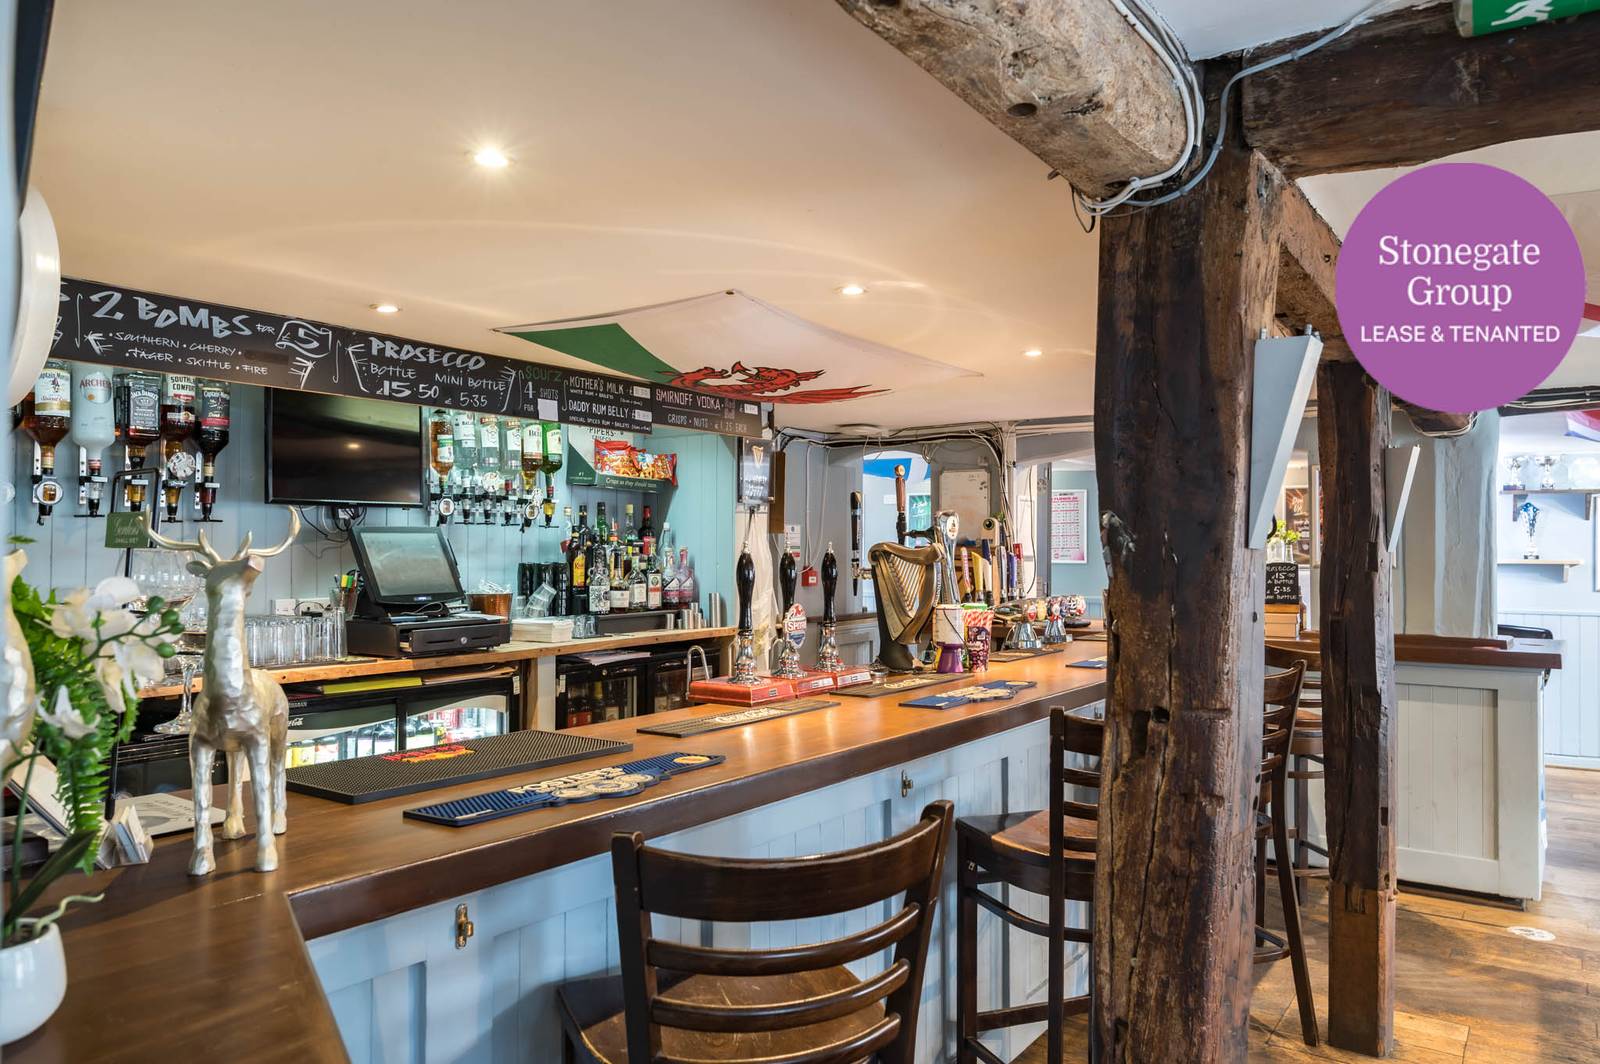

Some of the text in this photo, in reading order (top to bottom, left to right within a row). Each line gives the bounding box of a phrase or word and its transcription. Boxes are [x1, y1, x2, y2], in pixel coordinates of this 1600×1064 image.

[133, 296, 253, 339] BOMBS
[115, 332, 237, 356] SOUTHERN CHERRY
[368, 336, 486, 370] PROSECCO
[185, 357, 232, 370] SKITTLE
[242, 364, 268, 375] FIRE
[370, 362, 417, 379] BOTTLE
[435, 372, 506, 391] MINI BOTTLE
[524, 381, 536, 399] 4
[569, 375, 604, 392] MOTHER'S
[606, 382, 624, 395] MILK
[459, 392, 488, 407] 5.35
[655, 388, 693, 407] SMIRNOFF
[696, 395, 721, 410] VODKA
[568, 399, 591, 413] DADDY
[592, 403, 607, 415] RUM
[607, 406, 630, 419] BELLY
[667, 413, 688, 425] CRISPS
[588, 427, 614, 437] PIPERS
